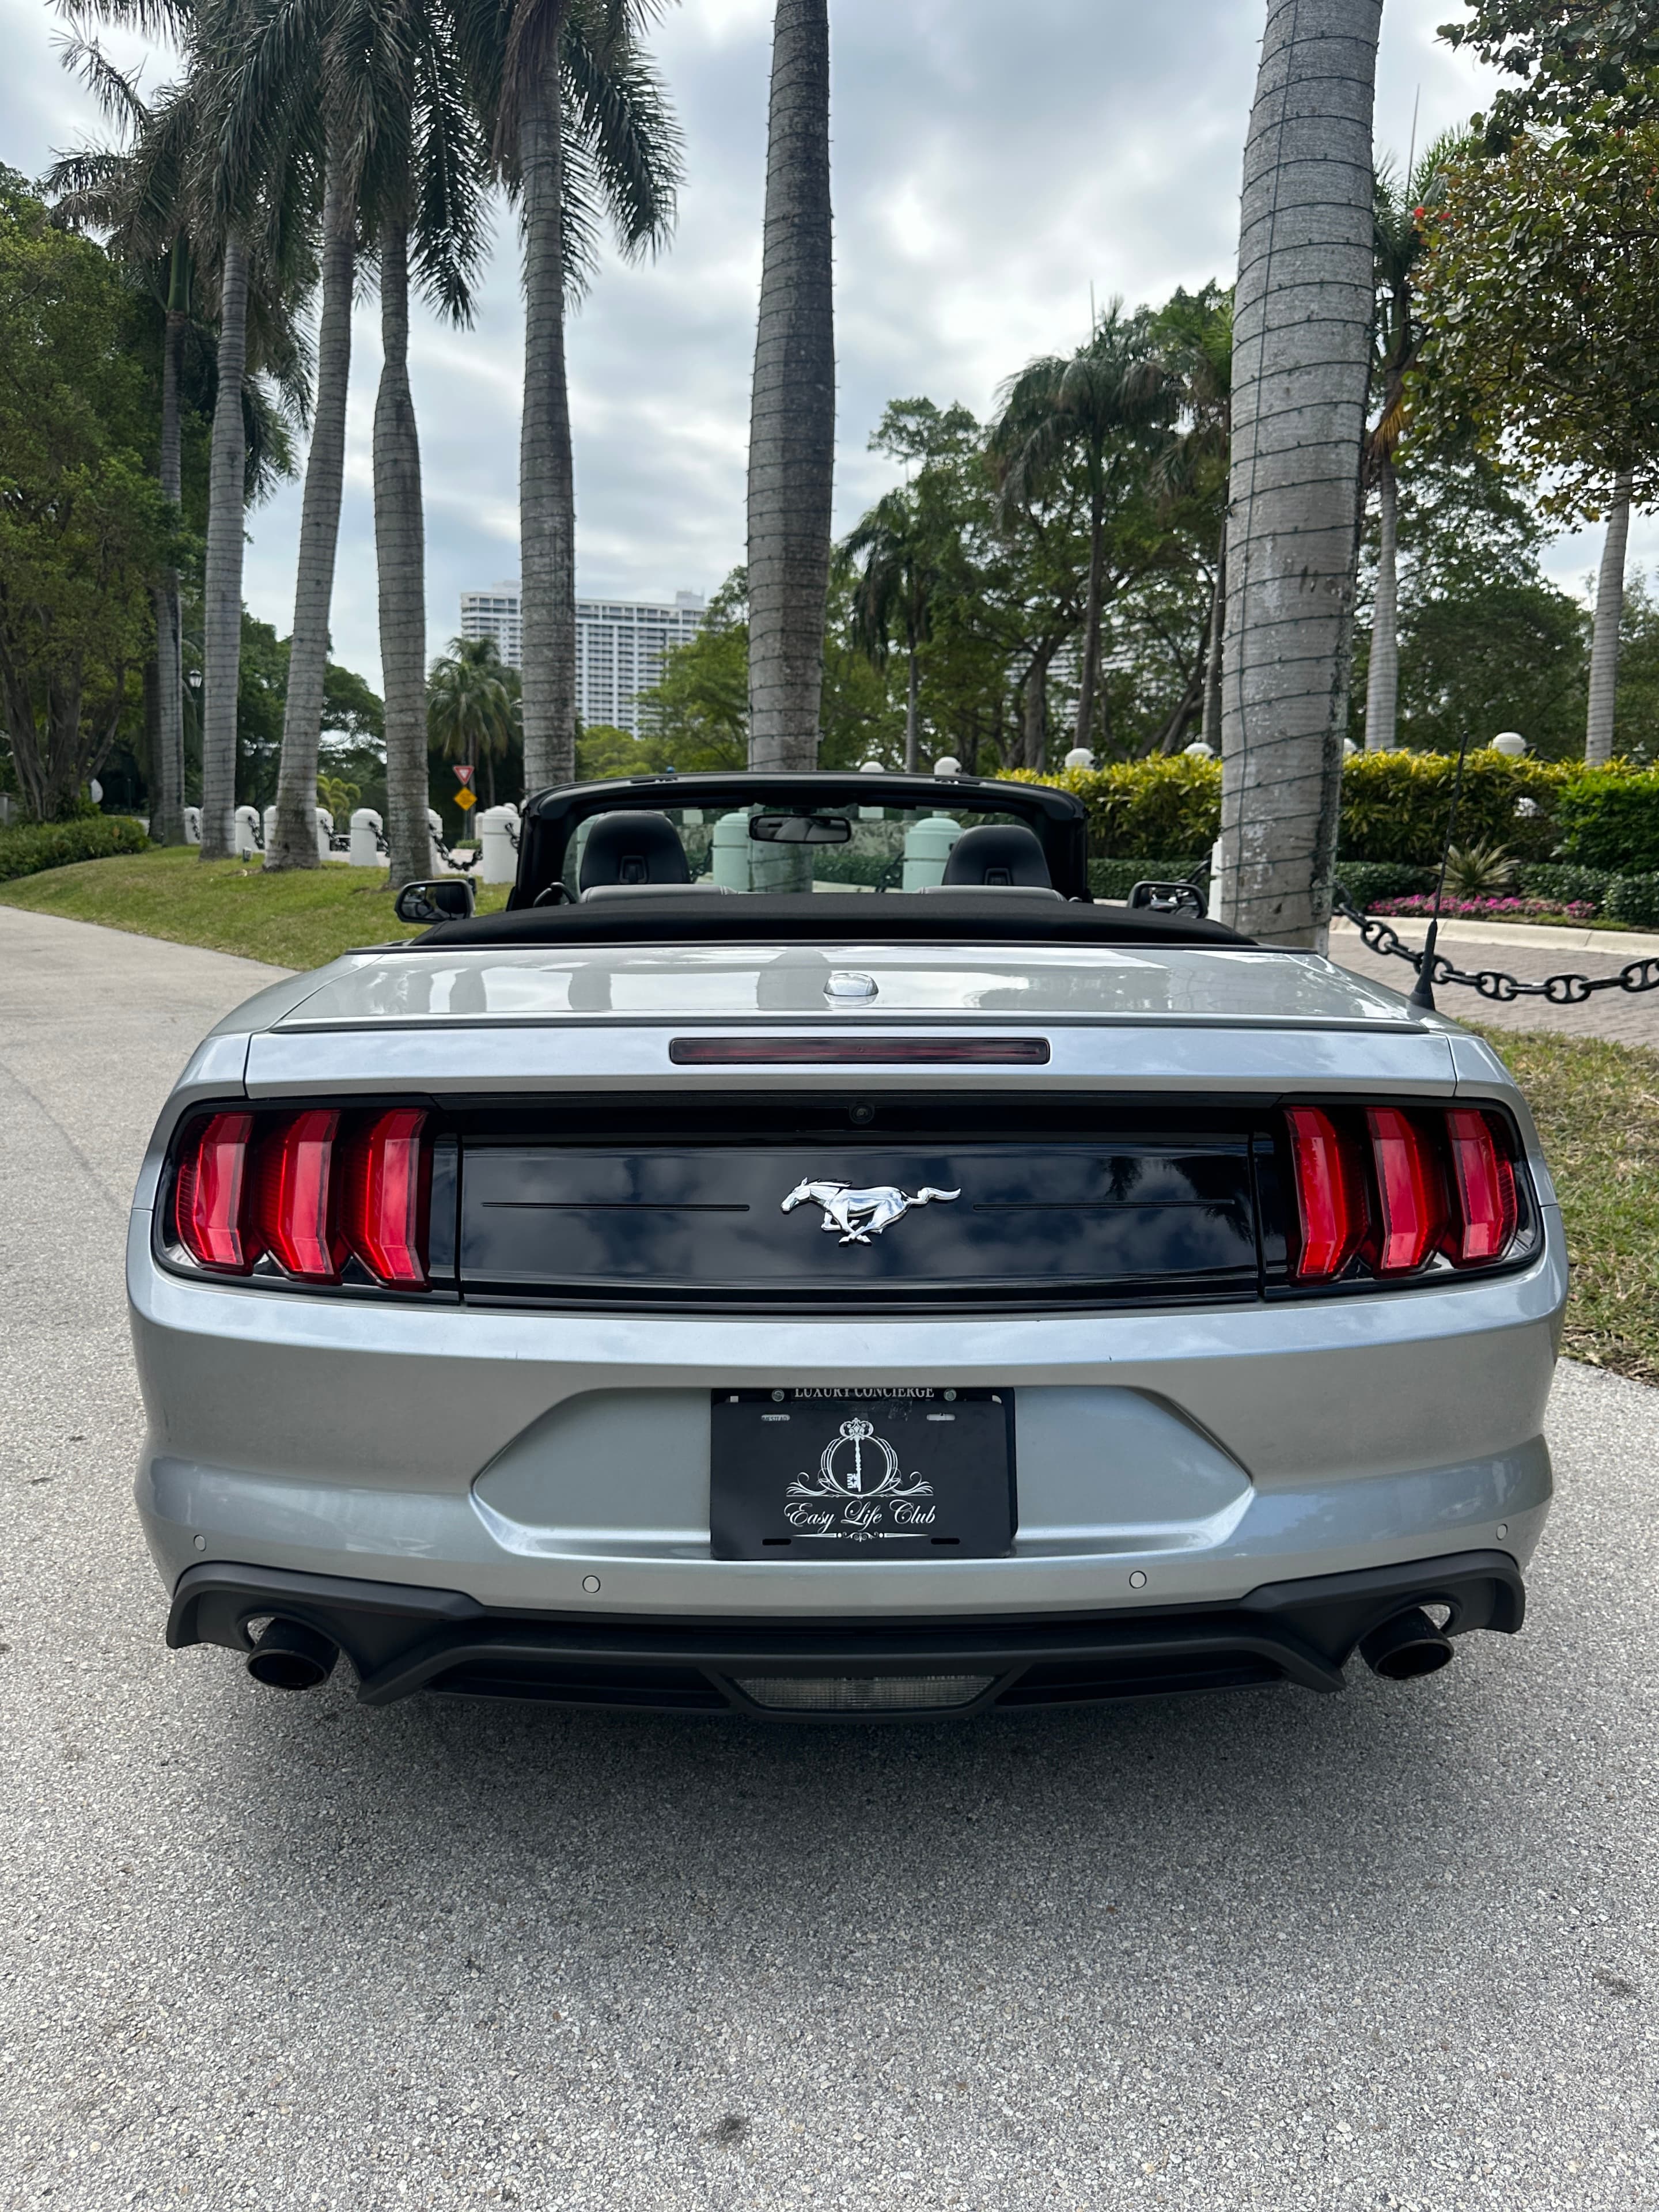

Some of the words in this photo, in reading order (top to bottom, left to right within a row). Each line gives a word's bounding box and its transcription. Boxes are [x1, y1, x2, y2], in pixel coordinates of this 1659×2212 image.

[855, 1388, 934, 1397] CONCIERGE
[784, 1502, 835, 1533] Easy
[840, 1500, 882, 1532] Life
[889, 1499, 935, 1524] Club
